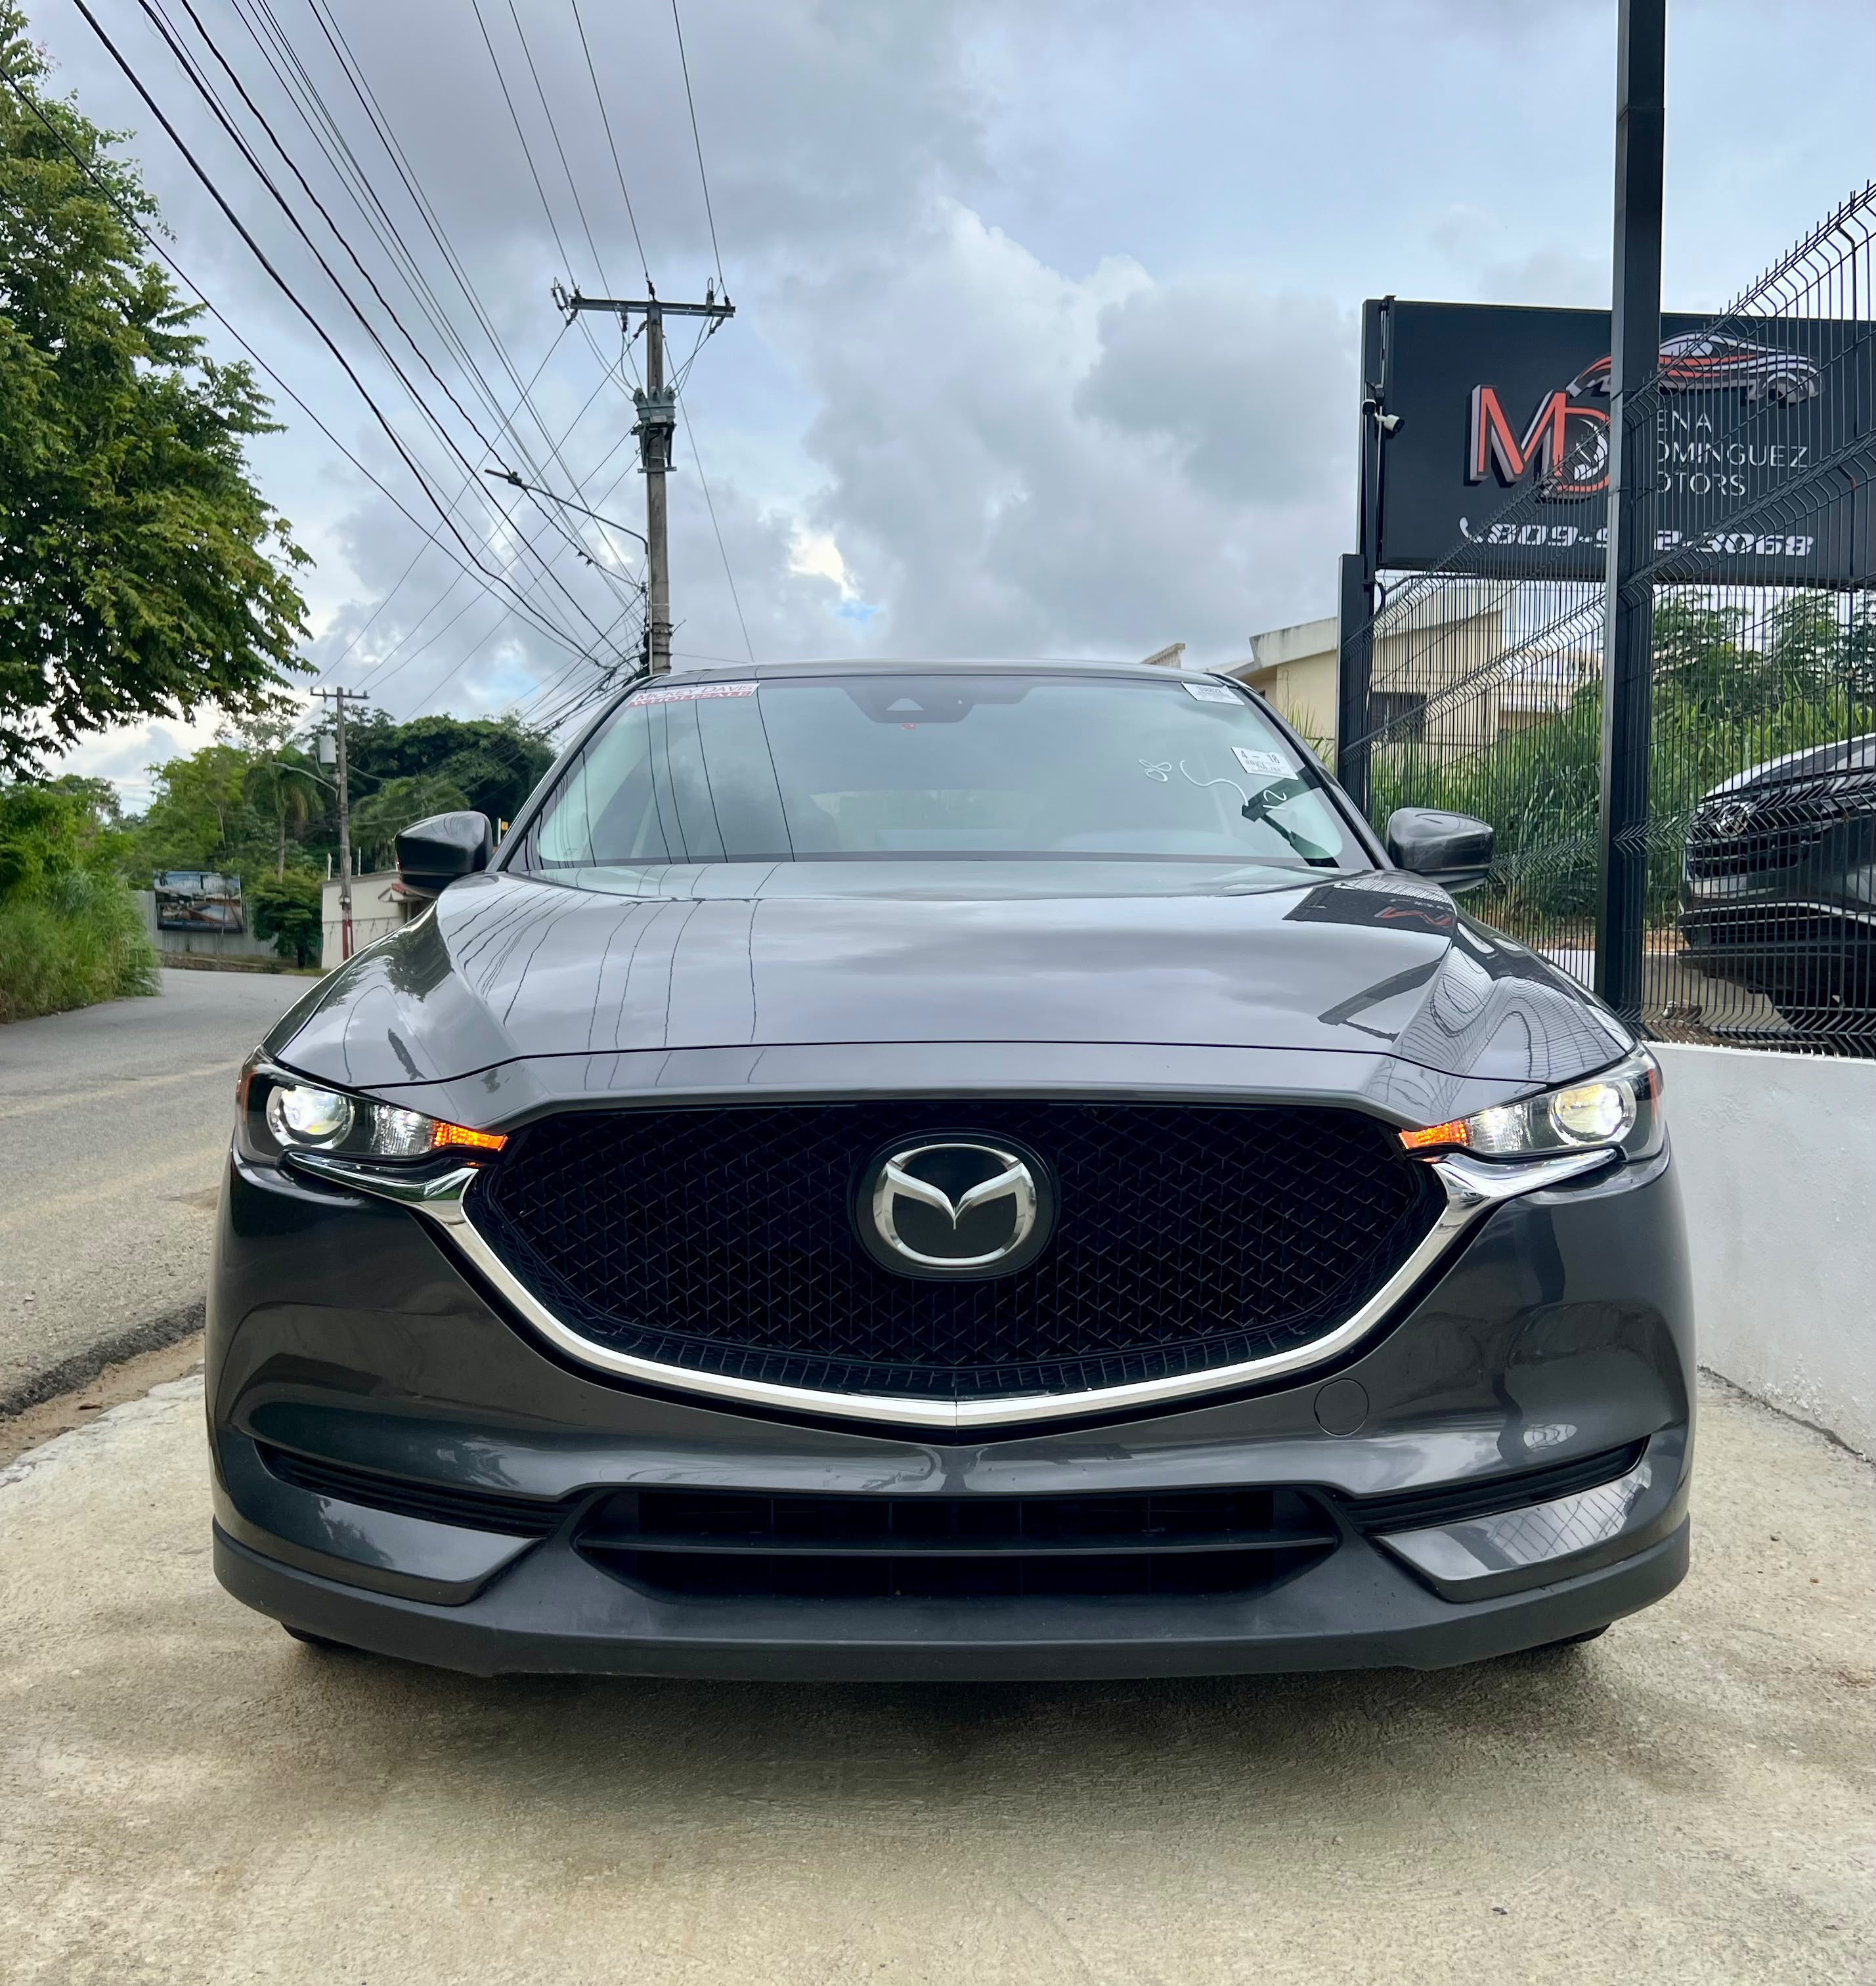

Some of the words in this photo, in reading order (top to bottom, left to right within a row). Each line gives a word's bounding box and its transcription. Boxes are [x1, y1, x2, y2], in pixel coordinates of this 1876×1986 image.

[1657, 409, 1712, 433] ENA
[1657, 439, 1808, 468] OMINGUEZ
[1657, 470, 1746, 496] OTORS
[1487, 523, 1814, 556] 809-92-3068
[636, 689, 698, 701] MICKEY
[702, 685, 753, 694] DAVIS
